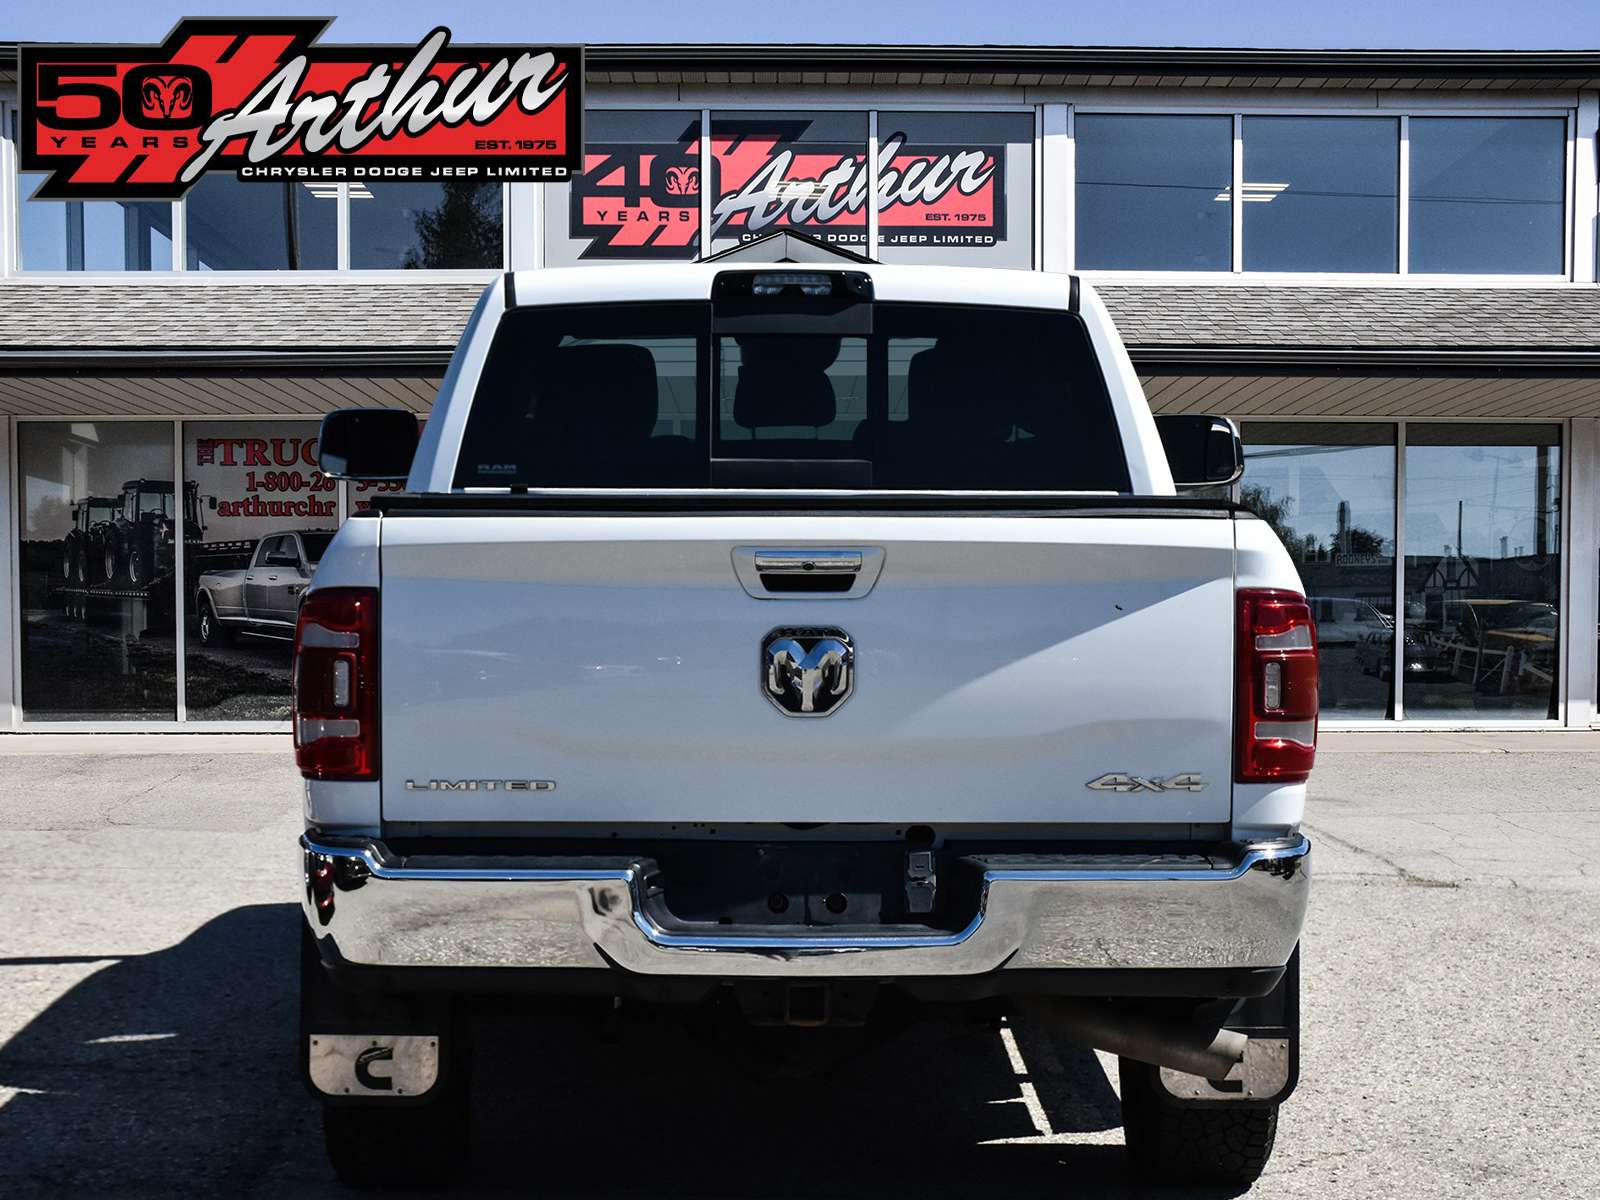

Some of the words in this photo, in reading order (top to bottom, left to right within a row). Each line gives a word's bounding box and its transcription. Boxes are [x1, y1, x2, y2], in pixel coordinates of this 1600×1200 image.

[583, 153, 721, 208] 40
[710, 136, 996, 230] Arthur
[597, 210, 690, 222] YEARS
[925, 213, 952, 222] EST.
[954, 213, 987, 222] 1975
[826, 234, 885, 243] DODGE
[890, 235, 928, 244] JEEP
[933, 235, 995, 244] LIMITED
[477, 463, 517, 474] RAM
[217, 495, 337, 517] arthurchr
[405, 779, 557, 792] LIMITED
